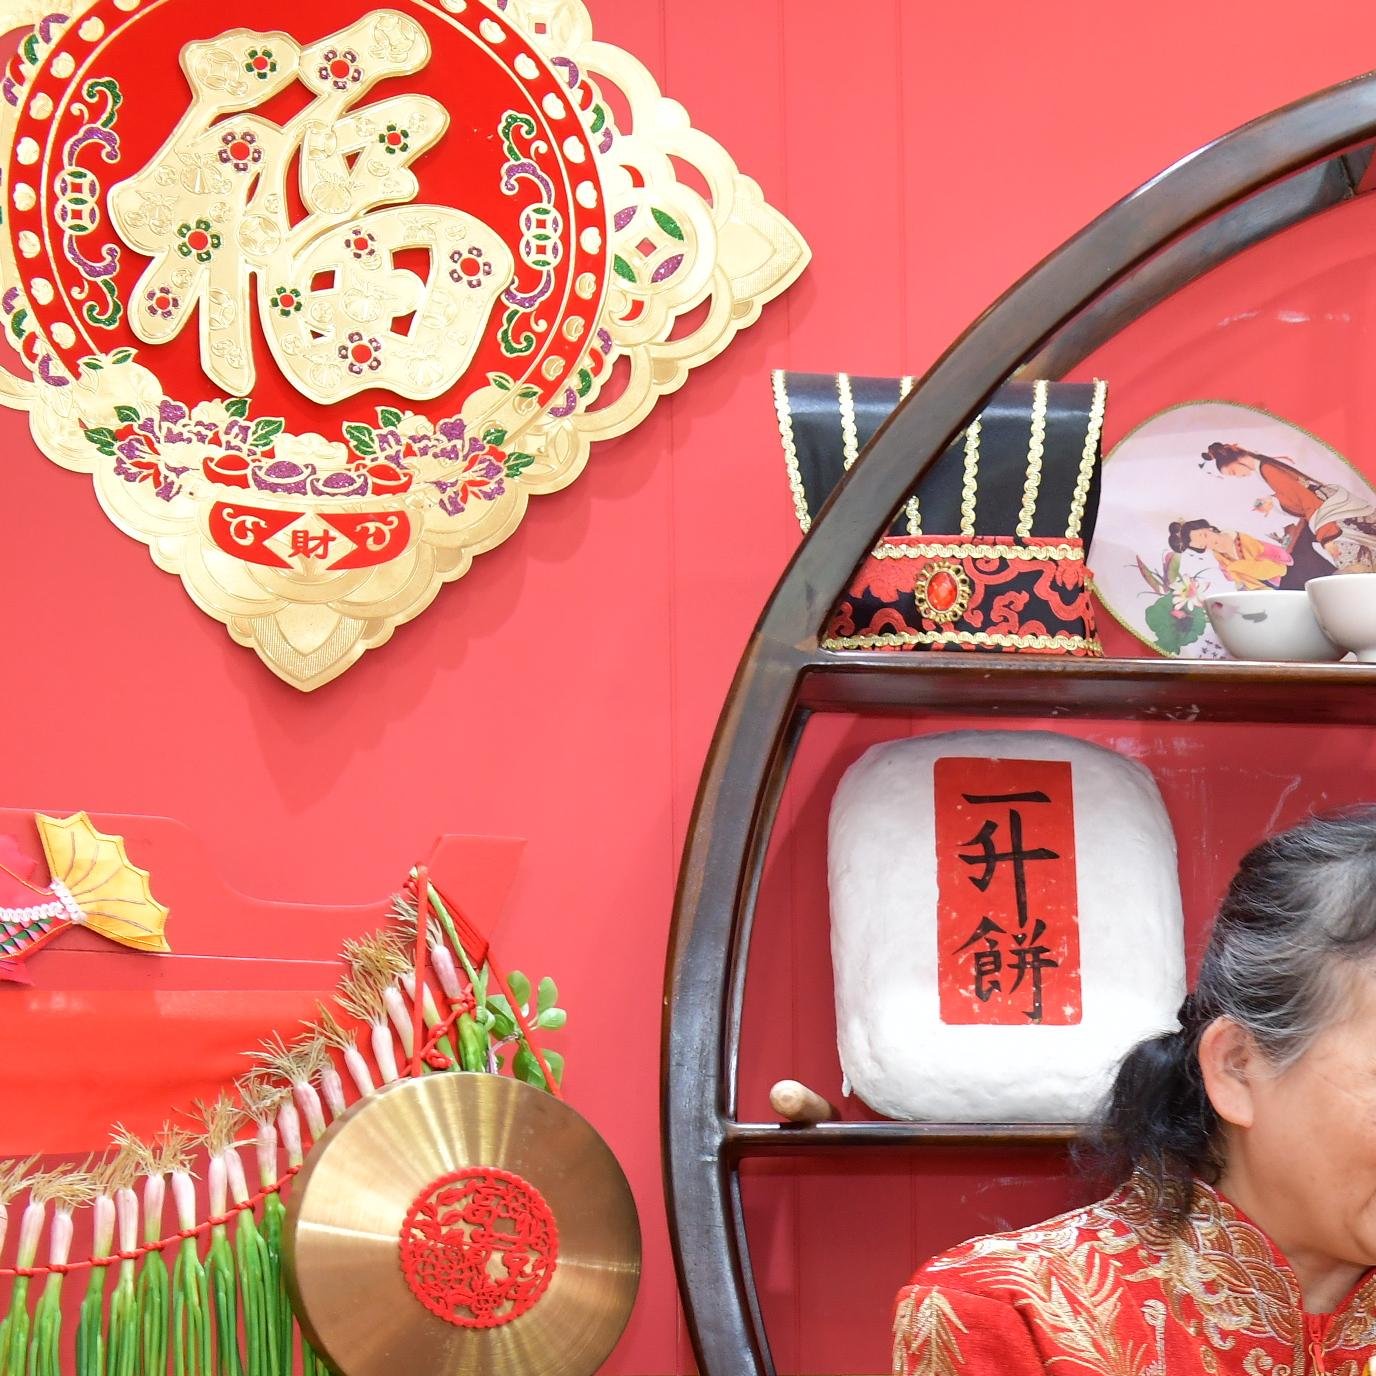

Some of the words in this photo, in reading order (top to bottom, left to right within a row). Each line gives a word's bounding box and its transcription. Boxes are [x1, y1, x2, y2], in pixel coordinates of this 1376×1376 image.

[109, 8, 513, 405] 福
[289, 528, 337, 561] 財
[952, 790, 1060, 1024] 一升餅
